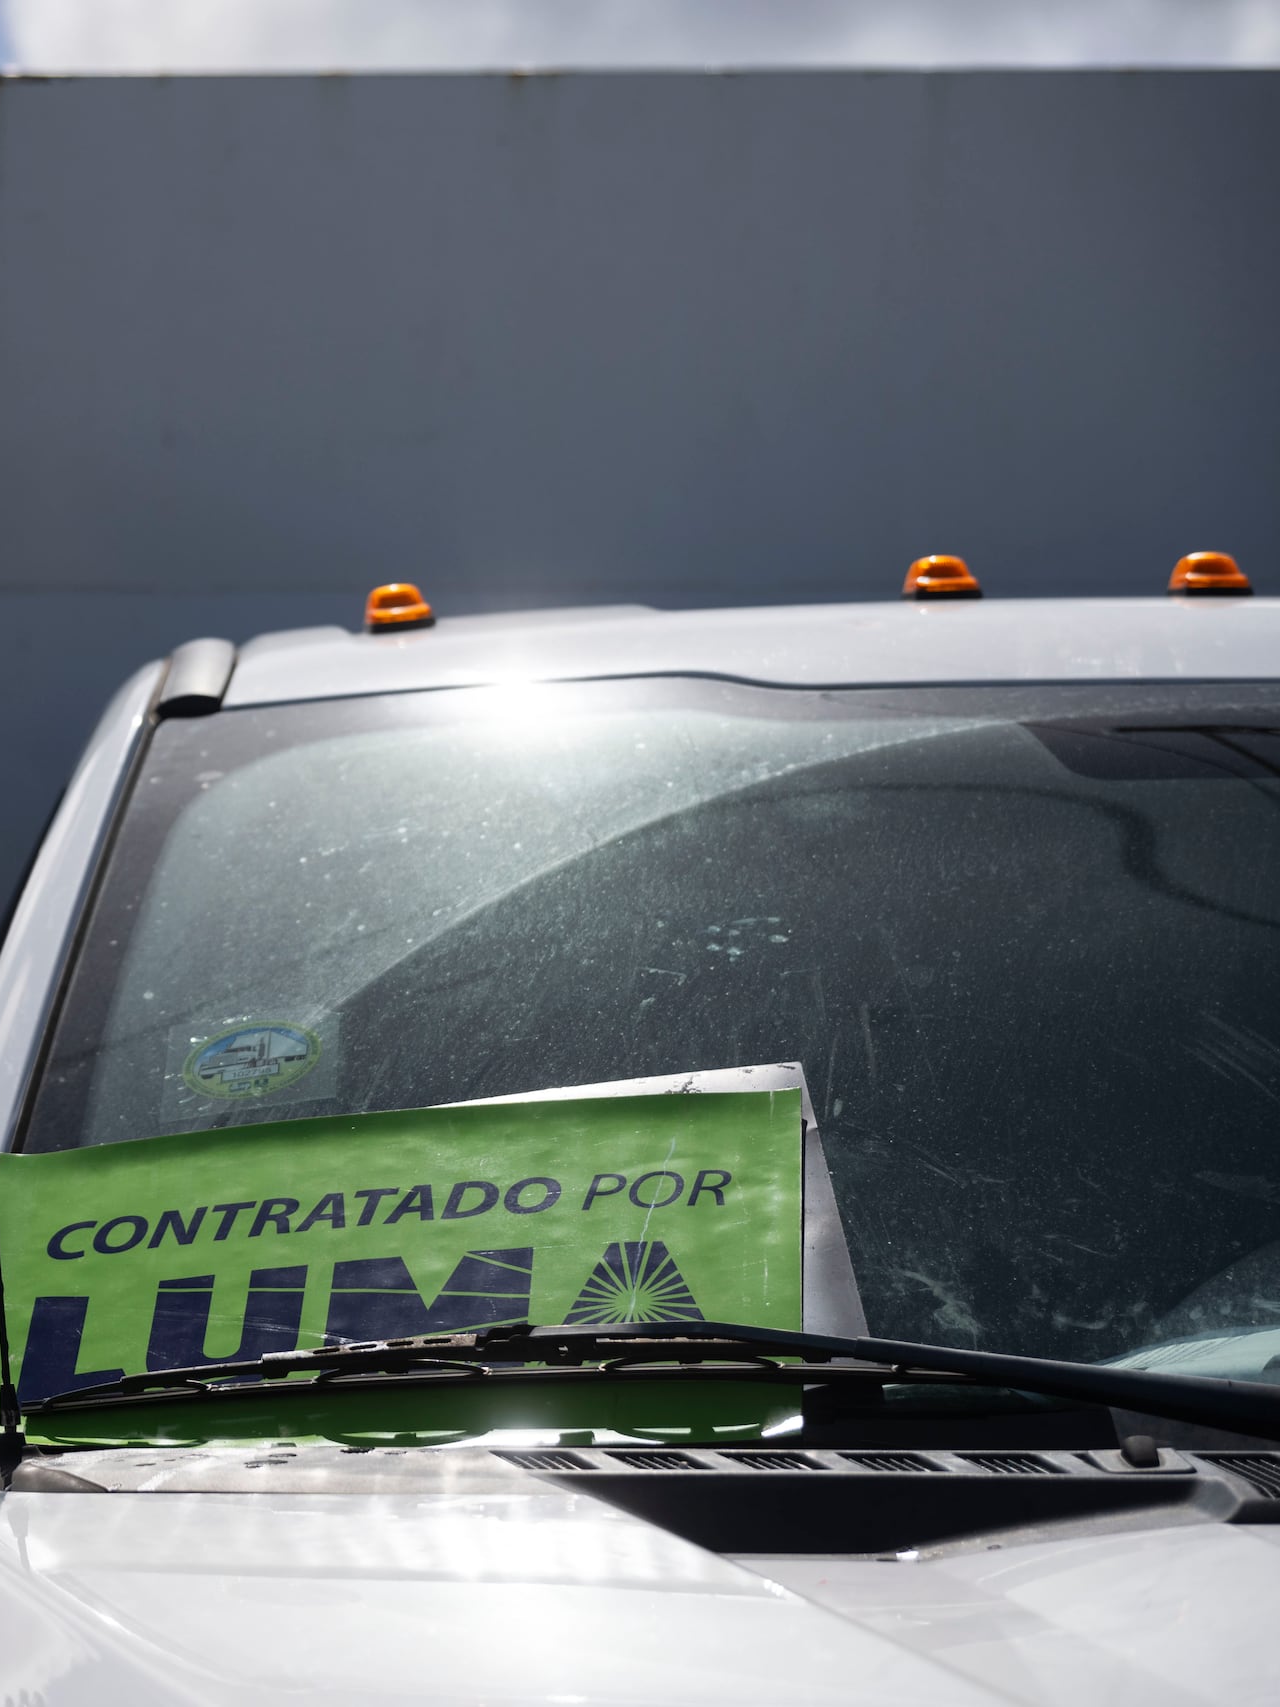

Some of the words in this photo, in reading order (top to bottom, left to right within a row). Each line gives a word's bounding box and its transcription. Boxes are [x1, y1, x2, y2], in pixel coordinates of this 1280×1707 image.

[46, 1176, 562, 1260] CONTRATADO
[581, 1169, 732, 1211] POR
[16, 1240, 706, 1403] LUMA
